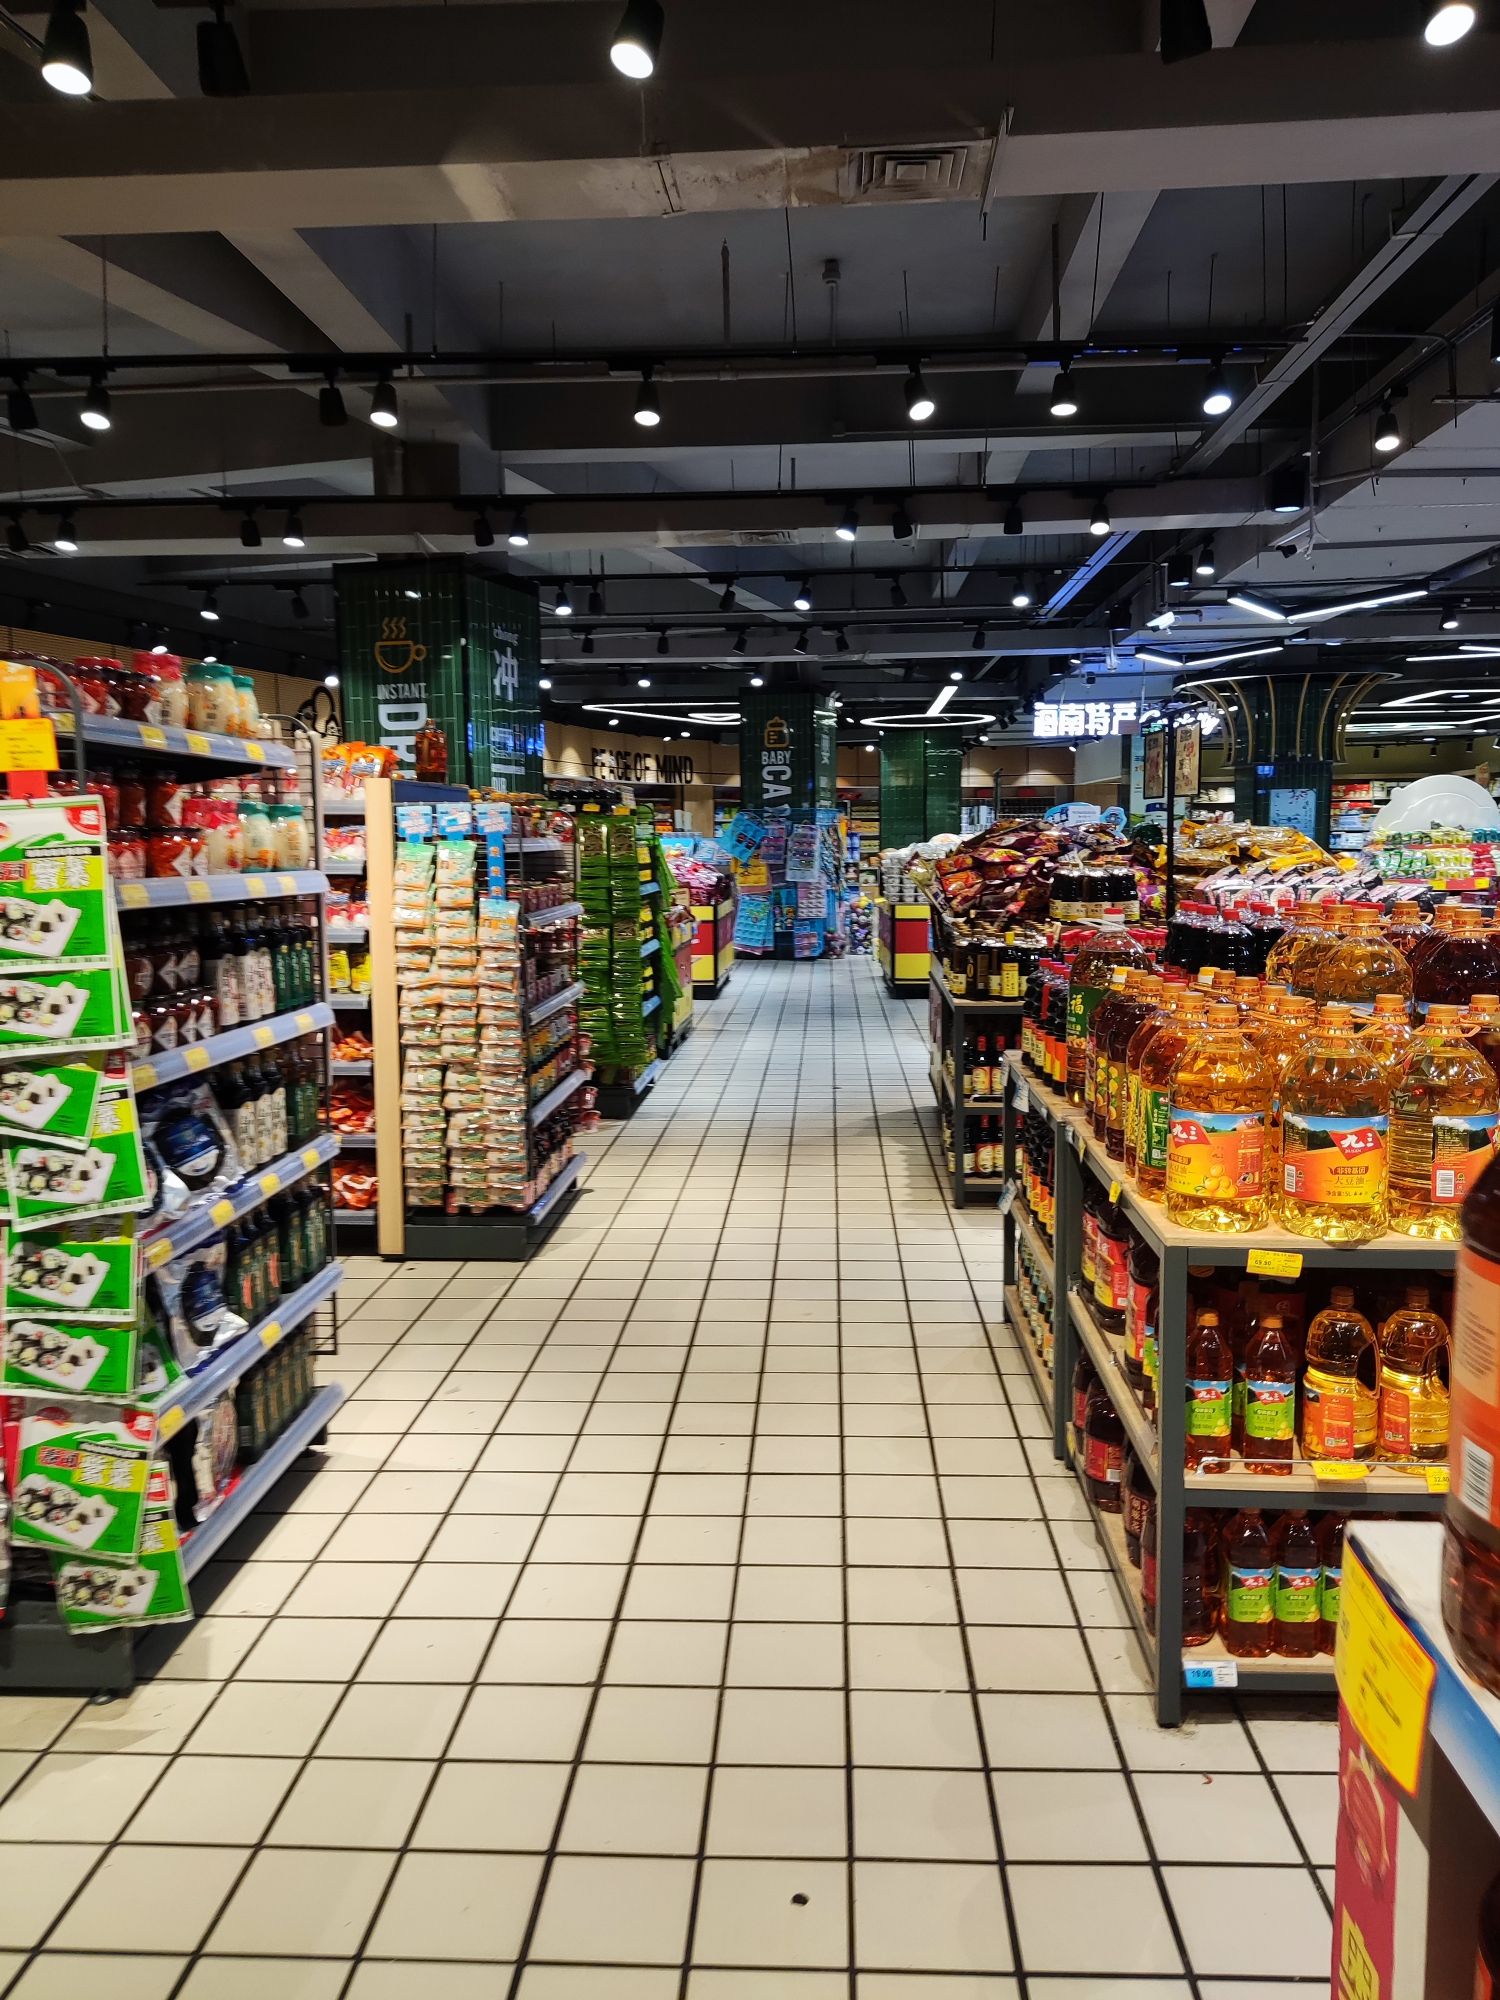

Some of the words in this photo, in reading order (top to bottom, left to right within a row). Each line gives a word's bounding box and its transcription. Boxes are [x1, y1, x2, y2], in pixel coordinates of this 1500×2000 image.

[377, 682, 427, 699] INSTANT
[1033, 702, 1137, 736] 海南特产
[761, 750, 791, 765] BABY
[655, 754, 693, 784] MIND
[1340, 1132, 1375, 1149] 九三
